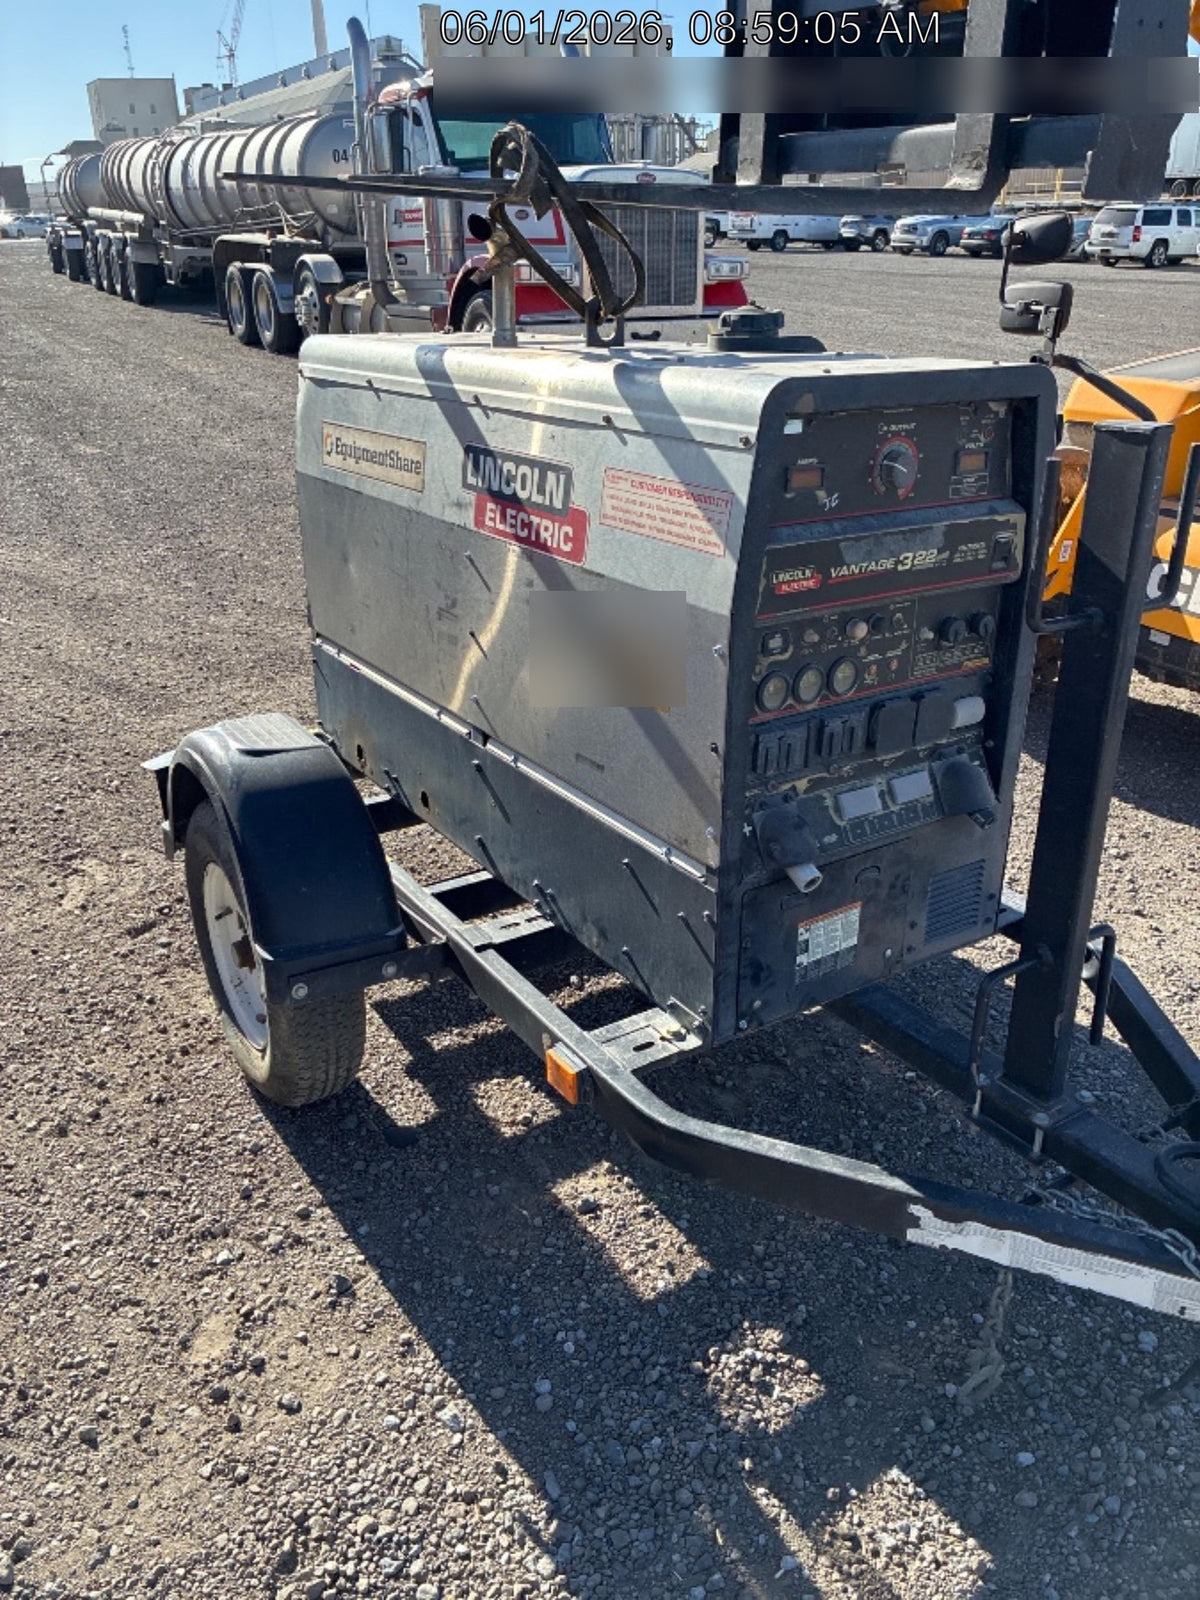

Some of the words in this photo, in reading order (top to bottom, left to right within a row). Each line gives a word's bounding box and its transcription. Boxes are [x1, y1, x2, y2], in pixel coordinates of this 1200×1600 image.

[335, 436, 422, 476] EquipmentShare
[466, 451, 566, 509] LINCOLN
[485, 502, 574, 552] ELECTRIC
[773, 568, 813, 584] LINCOLN
[829, 558, 897, 578] VANTAGE
[898, 549, 938, 572] 322
